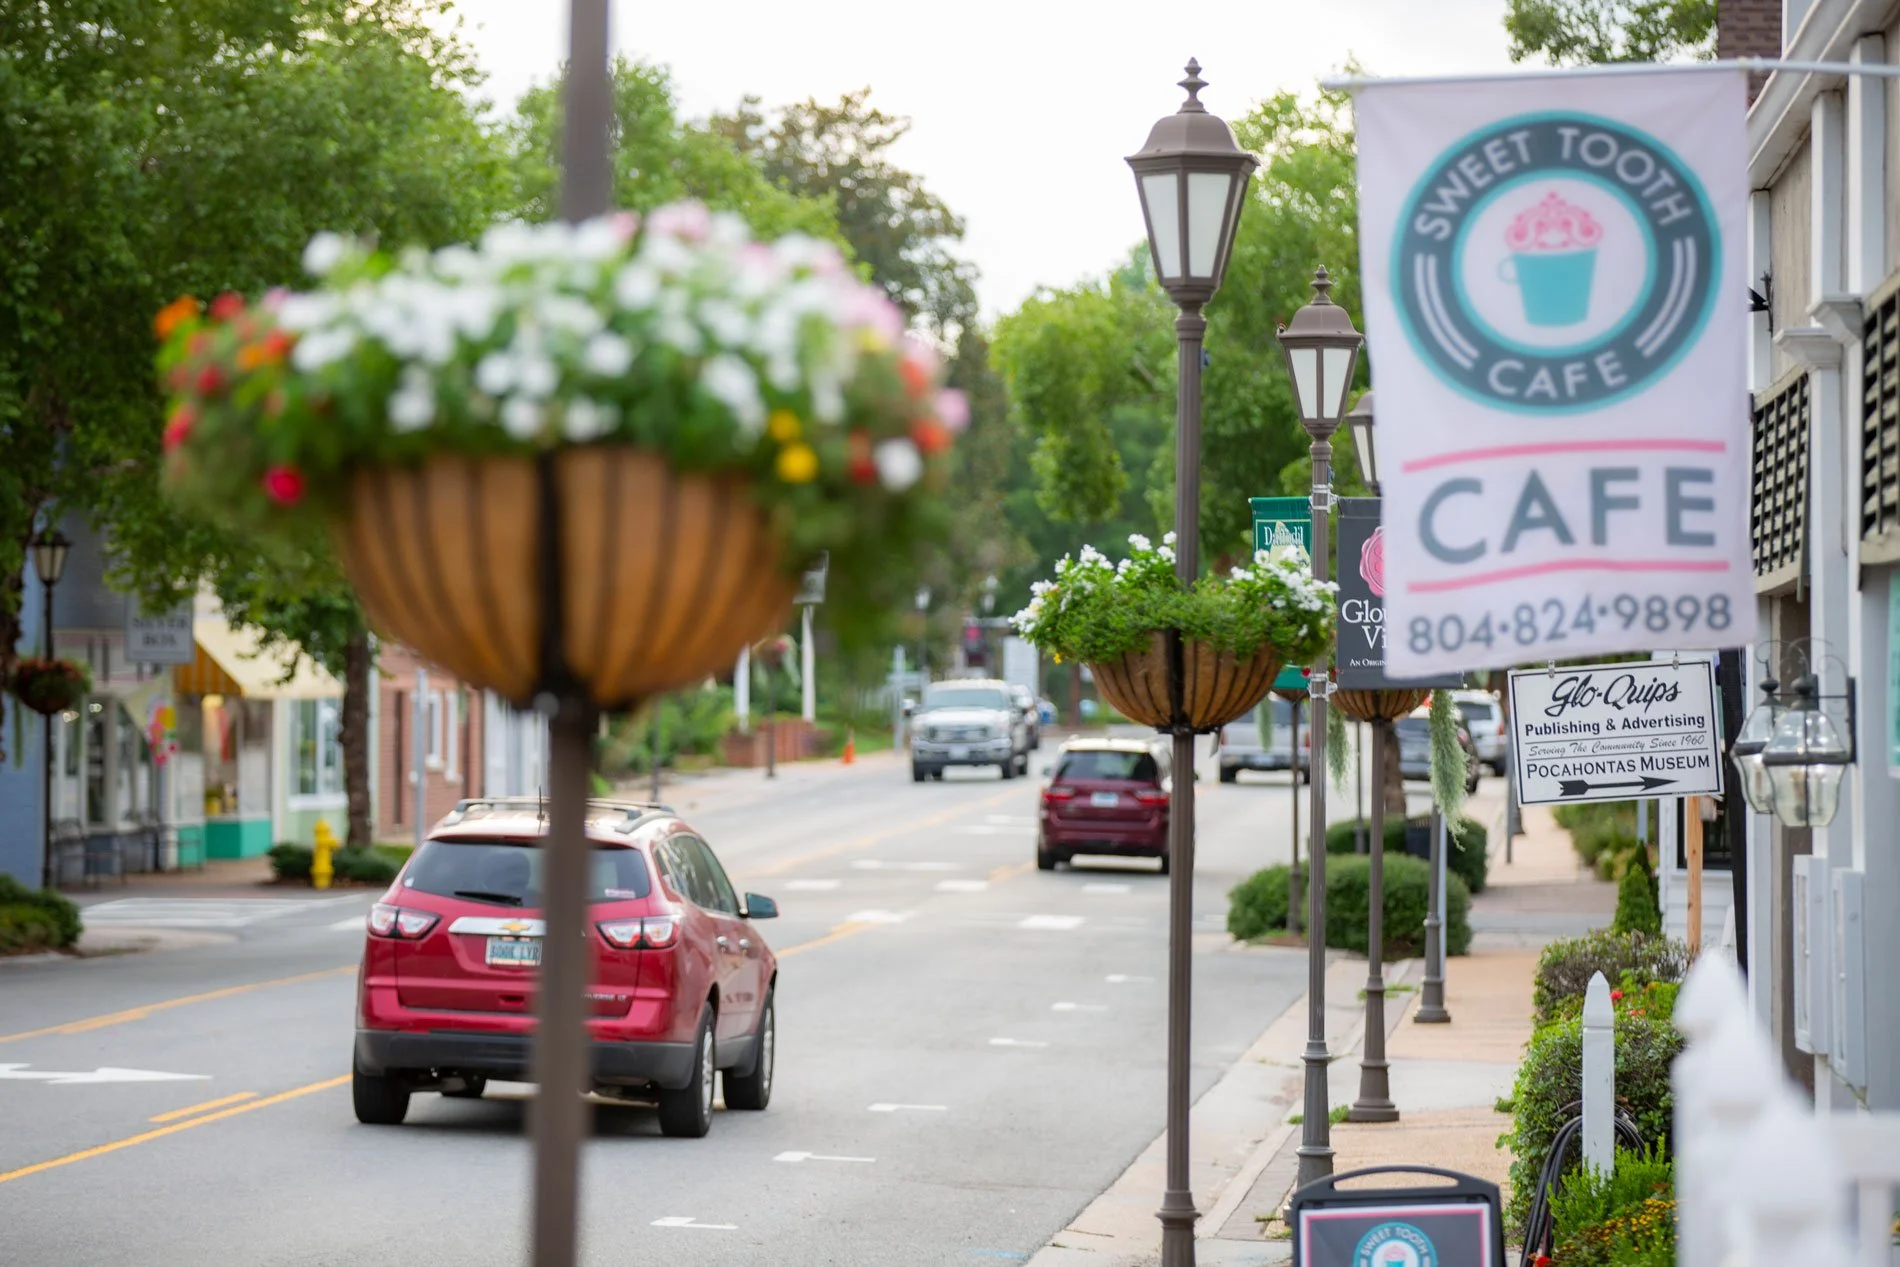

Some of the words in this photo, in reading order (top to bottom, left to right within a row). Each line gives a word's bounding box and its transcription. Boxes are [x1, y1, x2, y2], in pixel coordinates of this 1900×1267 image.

[1414, 130, 1531, 240] SWEET
[1558, 127, 1693, 226] TOOTH
[1488, 350, 1628, 399] CAFE
[1418, 466, 1716, 564] CAFE
[1361, 624, 1388, 650] Vi
[1525, 720, 1600, 737] Publishing
[1606, 718, 1616, 731] &
[1622, 713, 1705, 729] Advertising
[1528, 745, 1566, 758] Serving
[1569, 742, 1588, 753] The
[1591, 740, 1645, 754] Community
[1649, 737, 1677, 749] Since
[1680, 734, 1705, 746] 1960
[1527, 759, 1636, 779] POCAHONTAS
[1640, 755, 1710, 771] MUSEUM
[1361, 1227, 1391, 1255] SWEET
[1396, 1227, 1428, 1254] TOOTH
